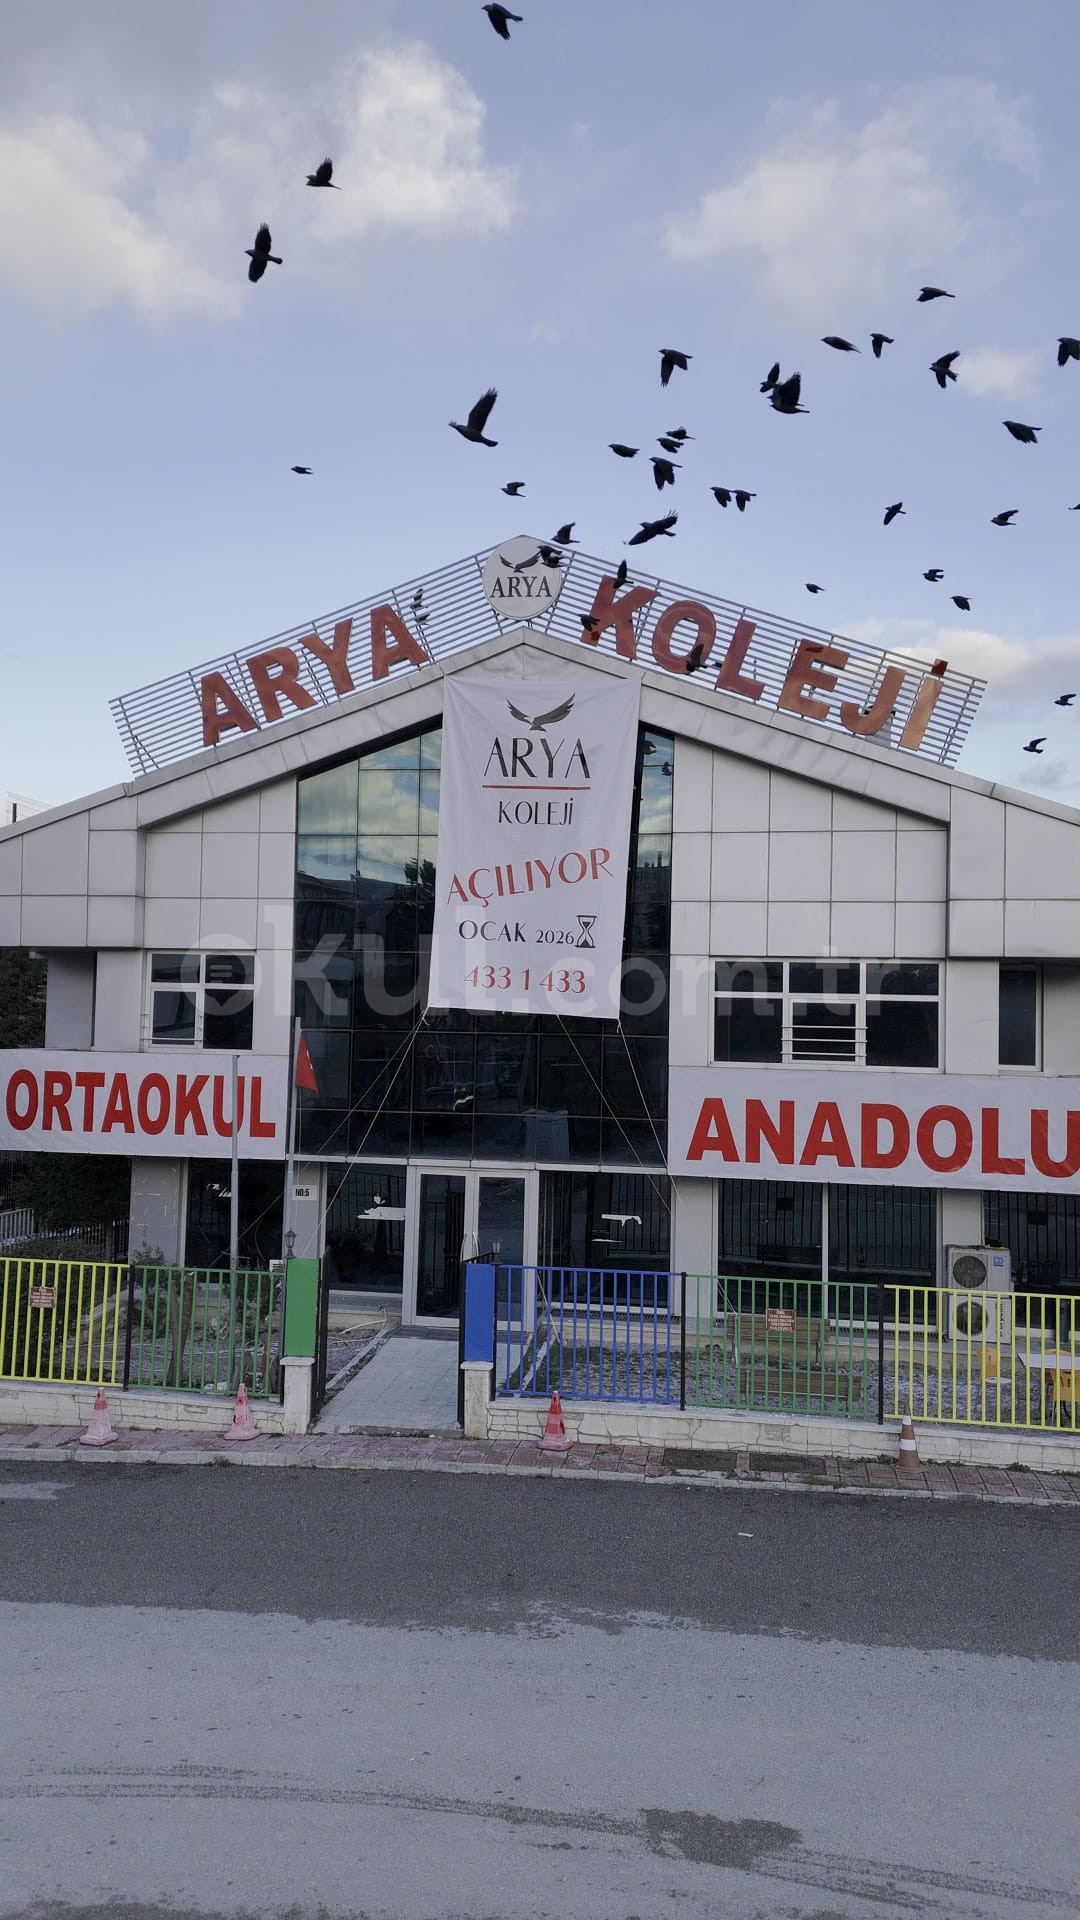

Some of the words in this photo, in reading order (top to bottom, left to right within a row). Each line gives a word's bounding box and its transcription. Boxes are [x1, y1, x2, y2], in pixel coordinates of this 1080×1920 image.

[489, 576, 553, 598] ARYA
[200, 603, 428, 747] ARYA
[580, 575, 949, 751] KOLEJİ
[483, 736, 591, 779] ARYA
[498, 797, 574, 826] KOLEJİ
[447, 847, 614, 908] AÇILIYOR
[458, 919, 528, 943] OCAK
[535, 929, 575, 945] 2026
[463, 965, 512, 990] 433
[539, 969, 587, 994] 433
[5, 1069, 276, 1138] ORTAOKUL
[685, 1097, 1080, 1179] ANADOLU
